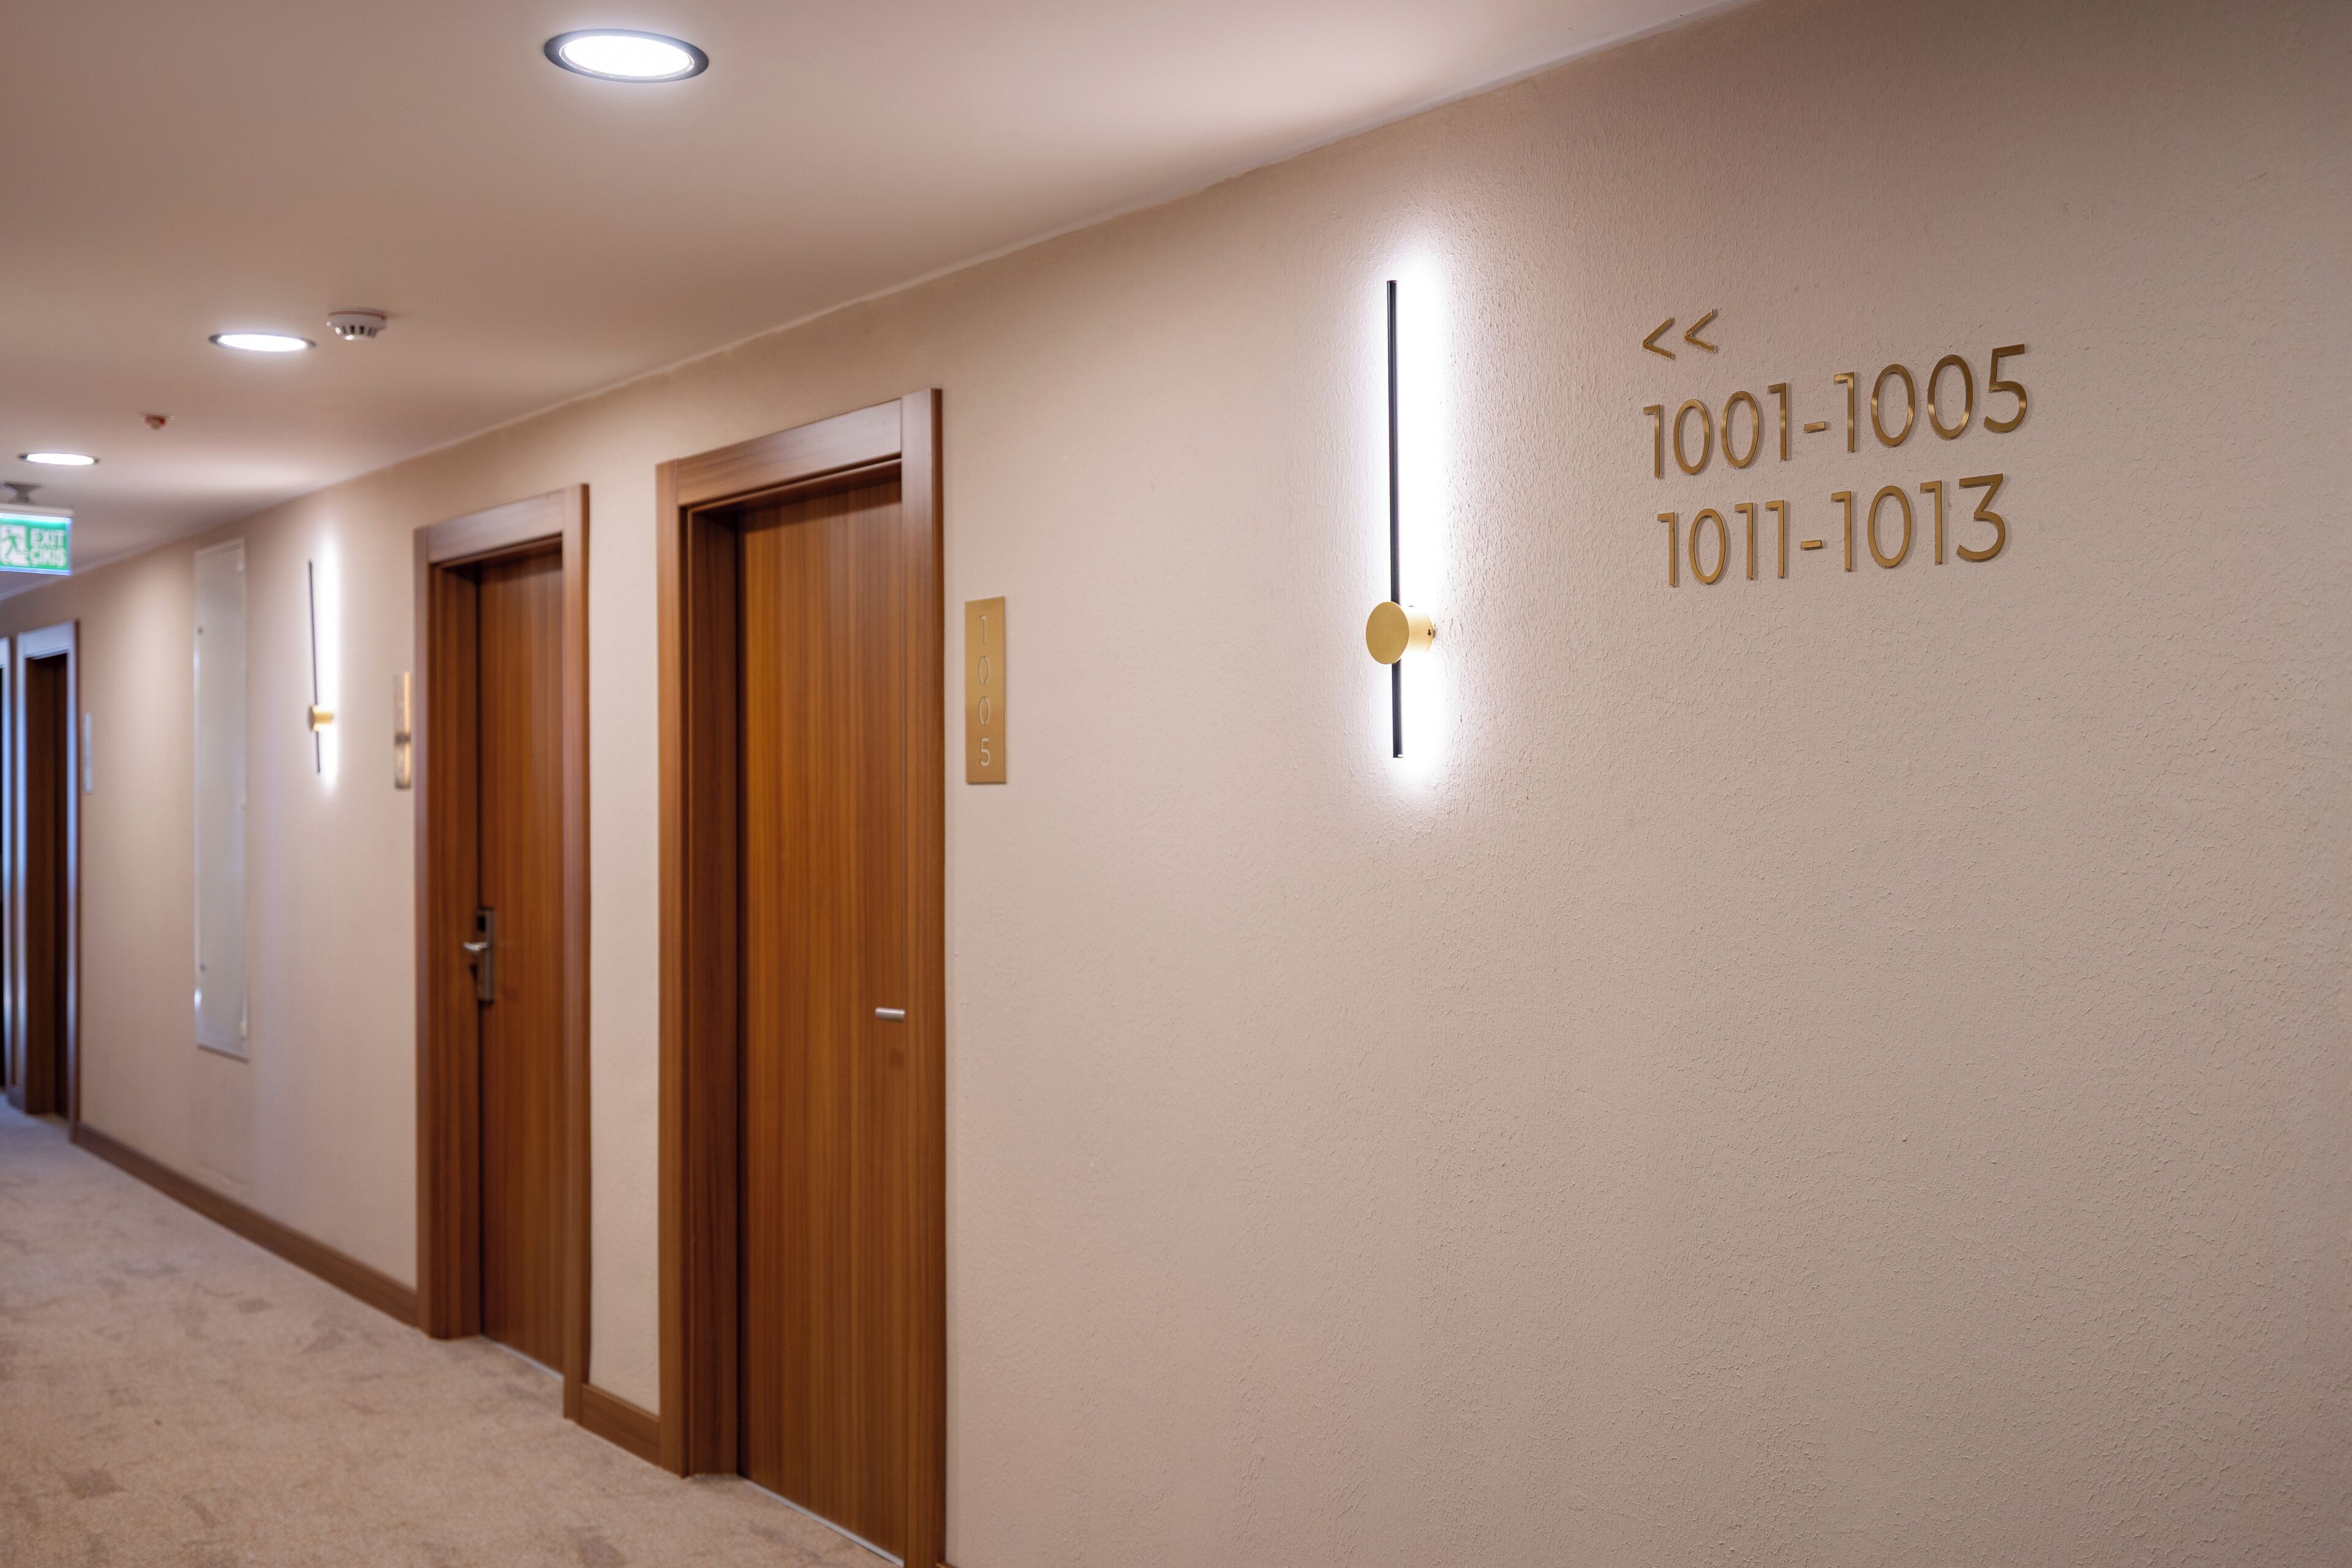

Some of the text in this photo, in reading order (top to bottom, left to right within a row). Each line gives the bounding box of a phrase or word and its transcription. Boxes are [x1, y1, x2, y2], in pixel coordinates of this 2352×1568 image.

[1643, 344, 2027, 477] 1001-1005
[31, 528, 66, 548] EXIT
[1657, 473, 2006, 587] 1011-1013
[978, 614, 990, 766] 1005
